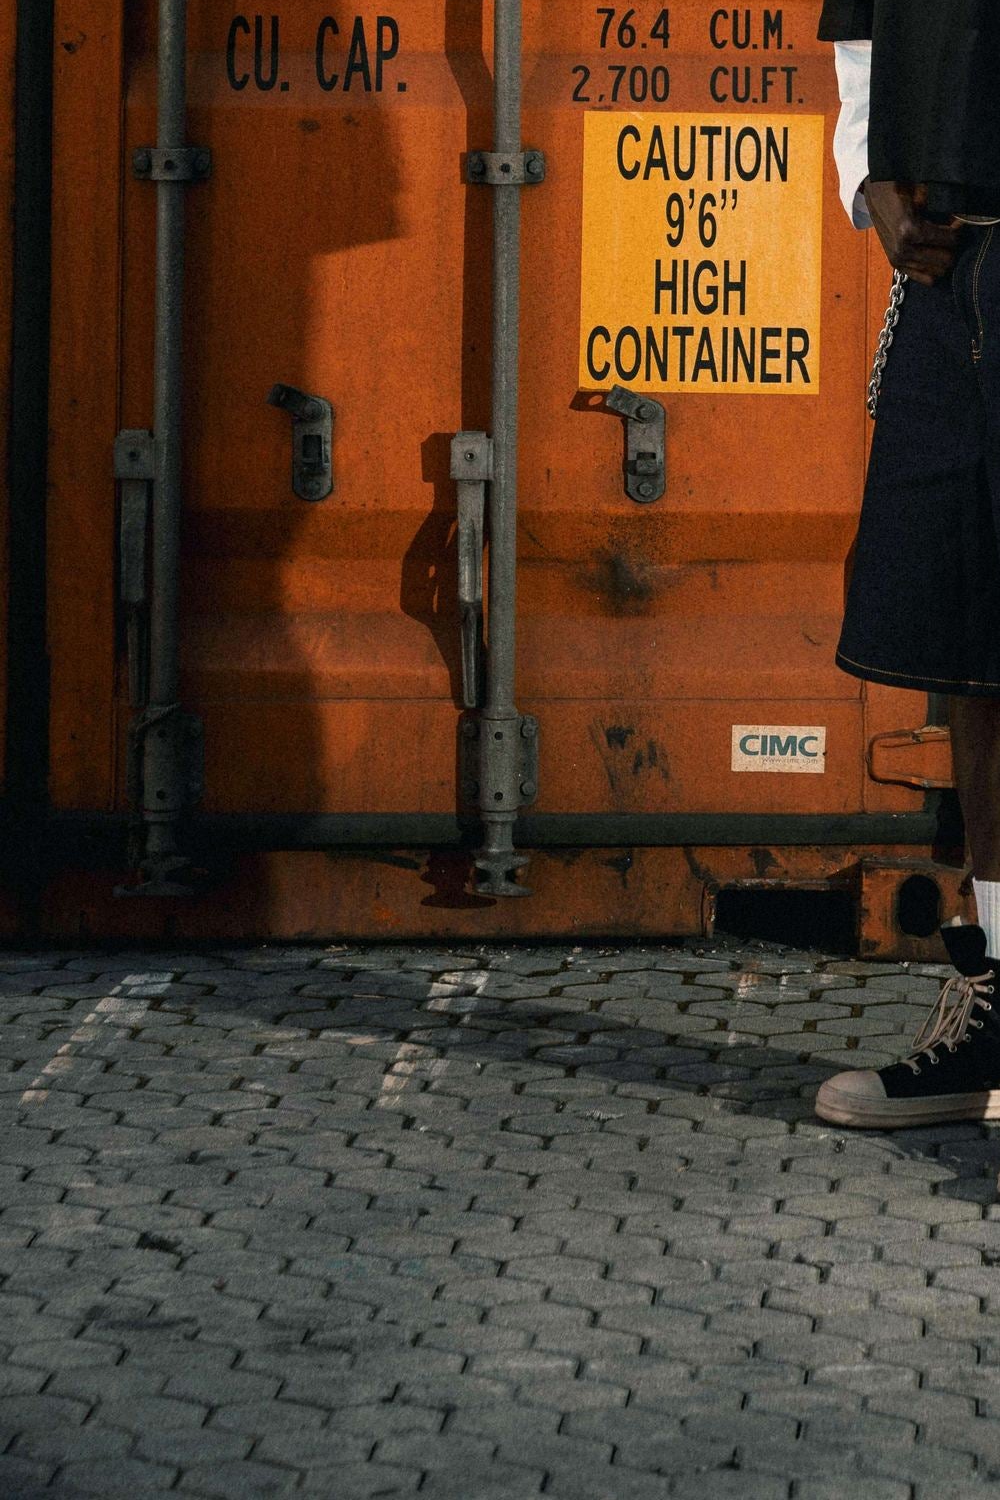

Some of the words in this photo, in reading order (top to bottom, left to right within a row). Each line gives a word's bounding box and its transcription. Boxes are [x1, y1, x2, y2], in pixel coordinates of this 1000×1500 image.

[225, 15, 289, 91] CU.
[315, 15, 408, 93] CAP.
[597, 8, 670, 48] 76.4
[572, 65, 670, 102] 2,700
[617, 125, 788, 182] CAUTION
[655, 259, 746, 316] HIGH
[587, 326, 810, 383] CONTAINER
[740, 735, 817, 757] CIMC
